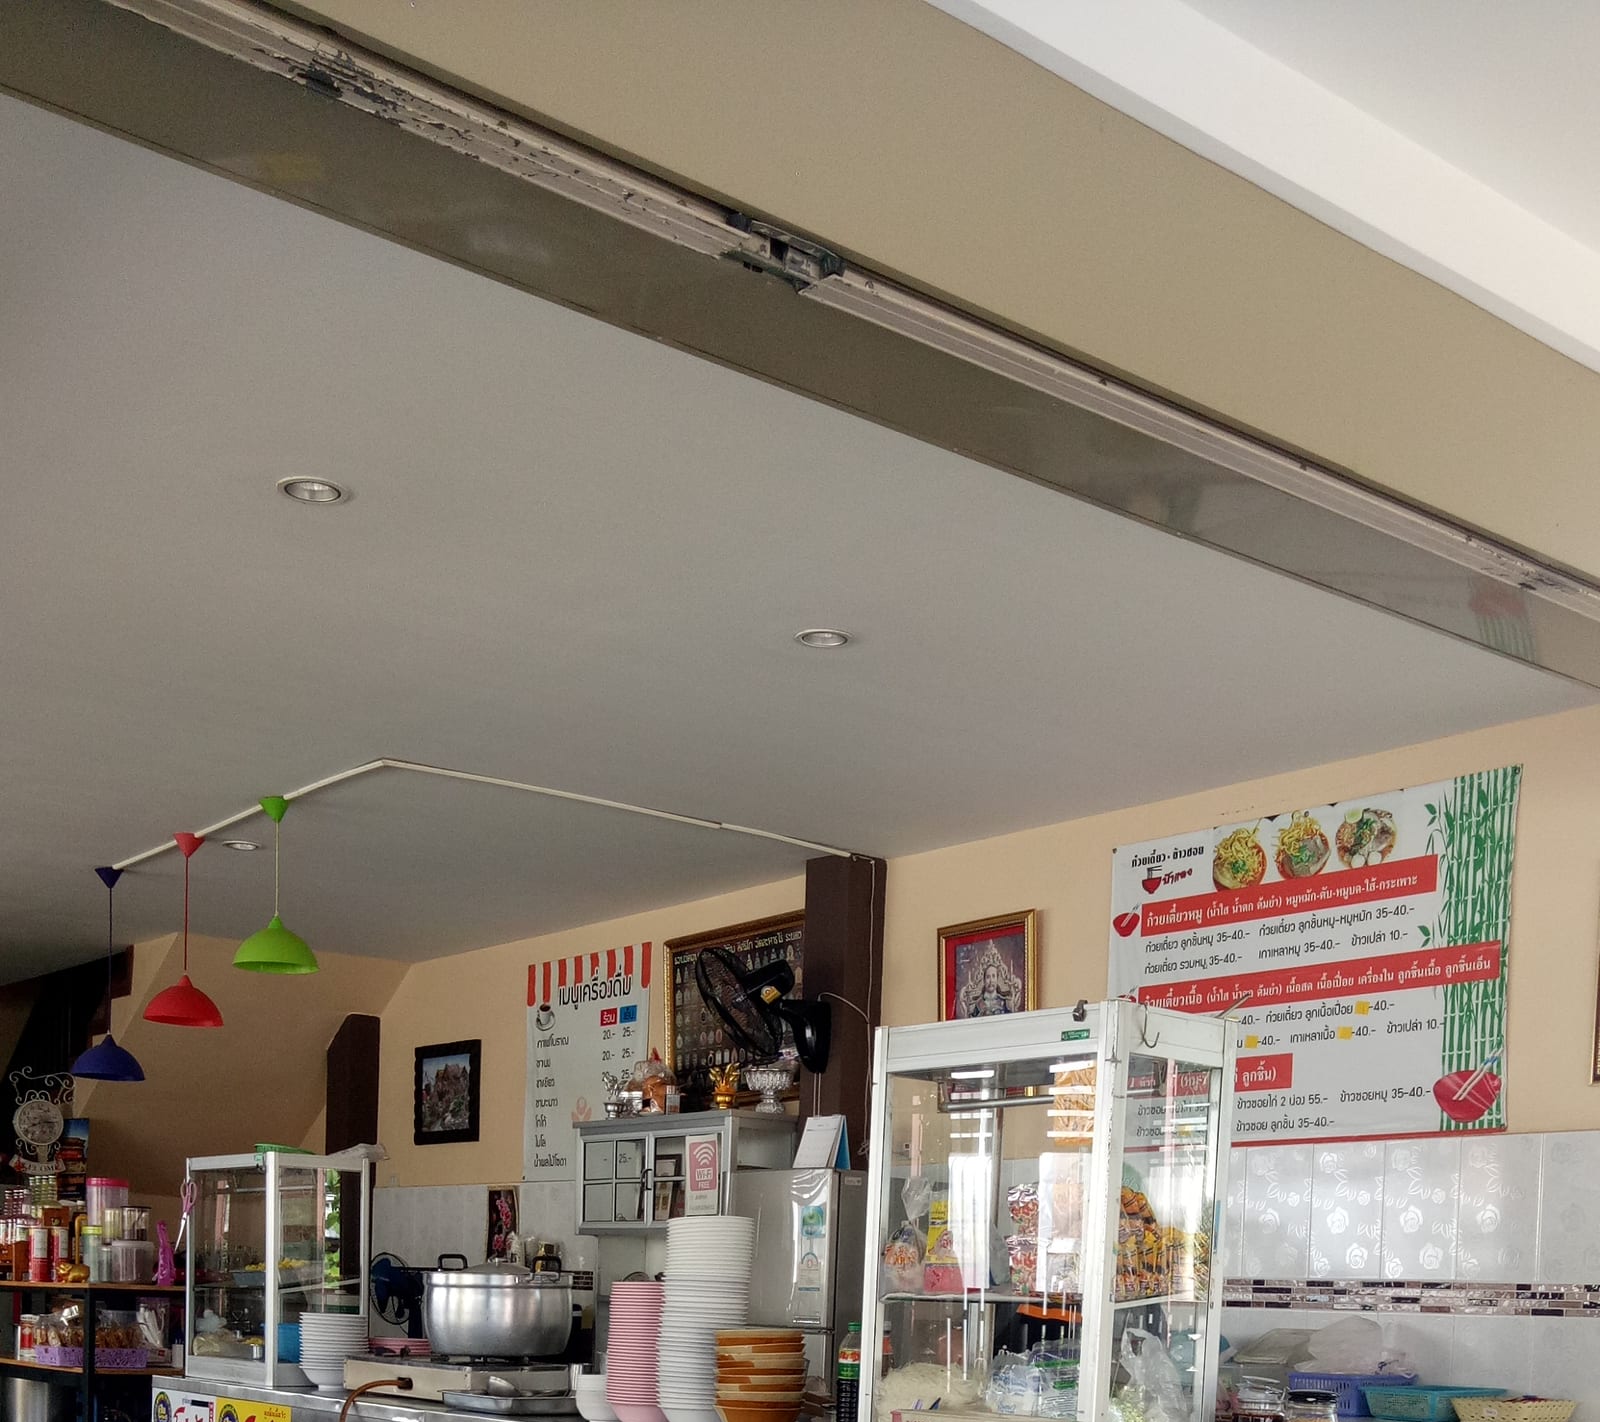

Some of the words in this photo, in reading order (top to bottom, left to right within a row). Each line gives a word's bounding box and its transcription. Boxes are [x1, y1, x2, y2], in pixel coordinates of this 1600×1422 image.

[559, 965, 632, 1011] เมนูเครื่องดื่ม
